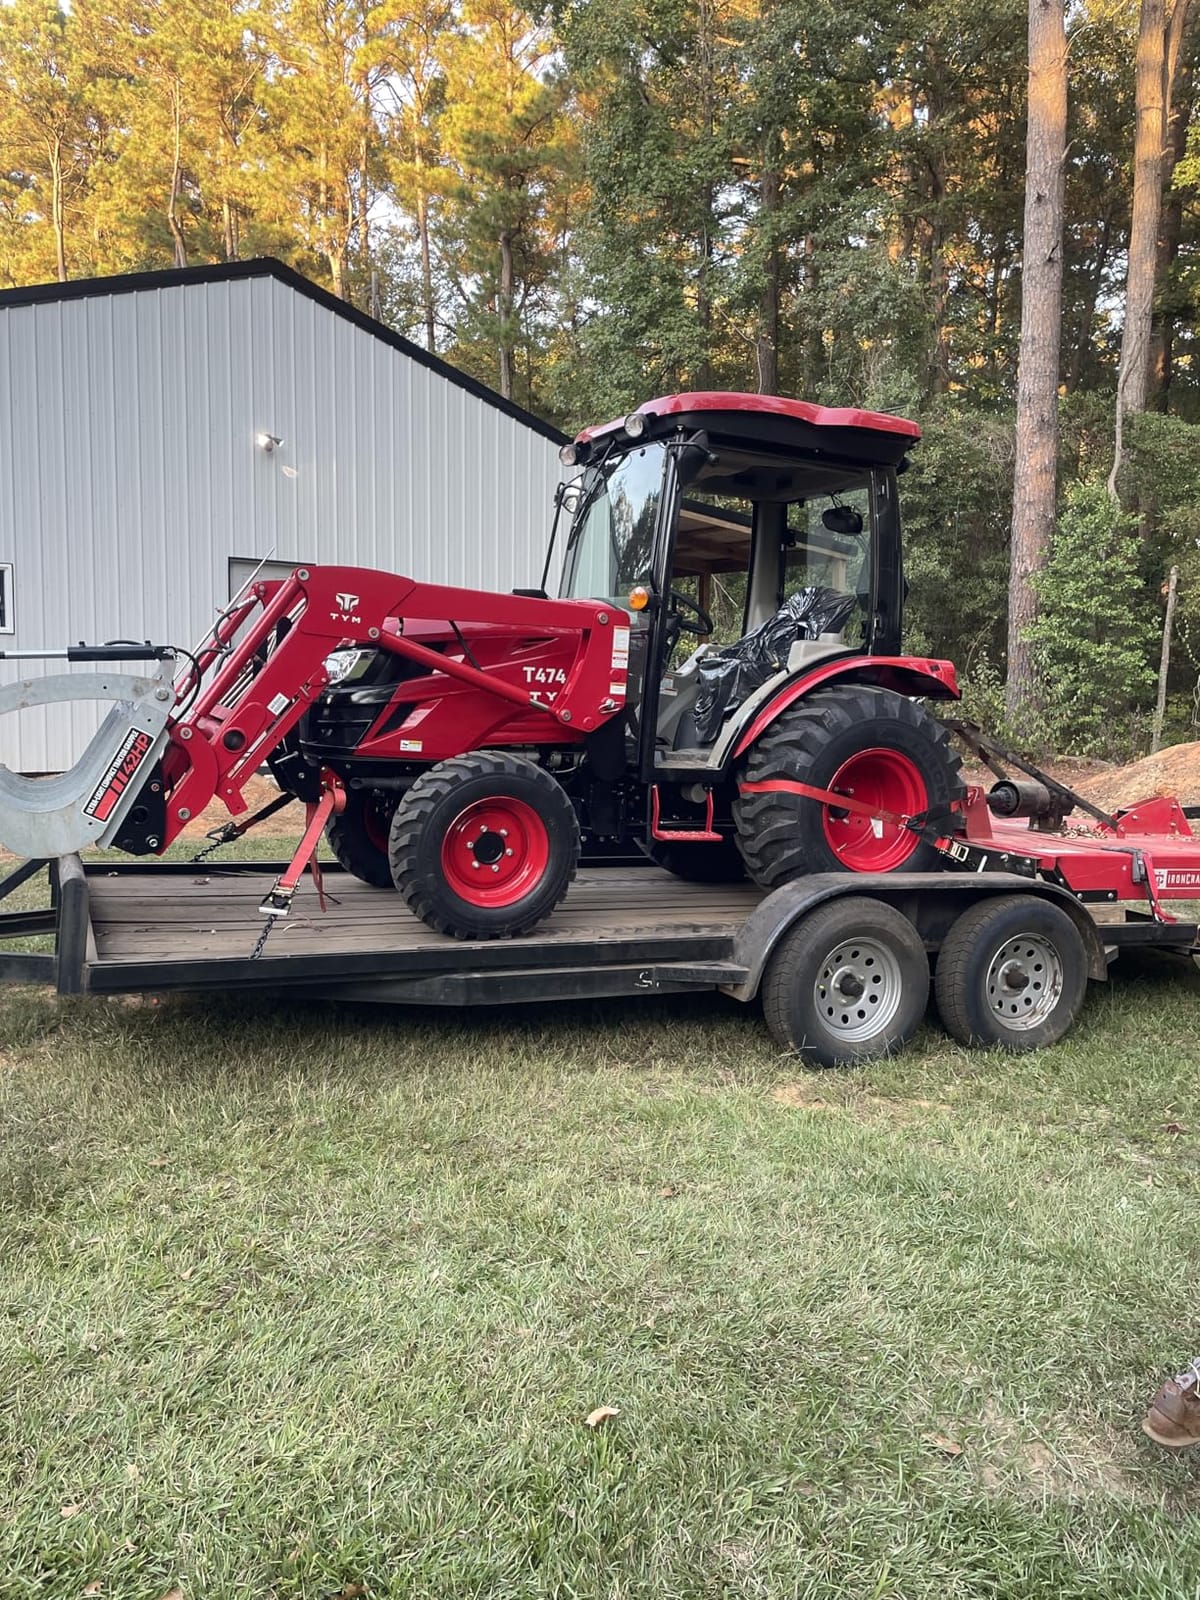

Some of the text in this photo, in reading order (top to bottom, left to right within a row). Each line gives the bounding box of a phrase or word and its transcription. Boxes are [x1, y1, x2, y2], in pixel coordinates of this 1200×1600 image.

[330, 612, 361, 624] TYM
[522, 666, 567, 684] T474
[529, 691, 558, 702] TY
[123, 734, 149, 775] 42HP
